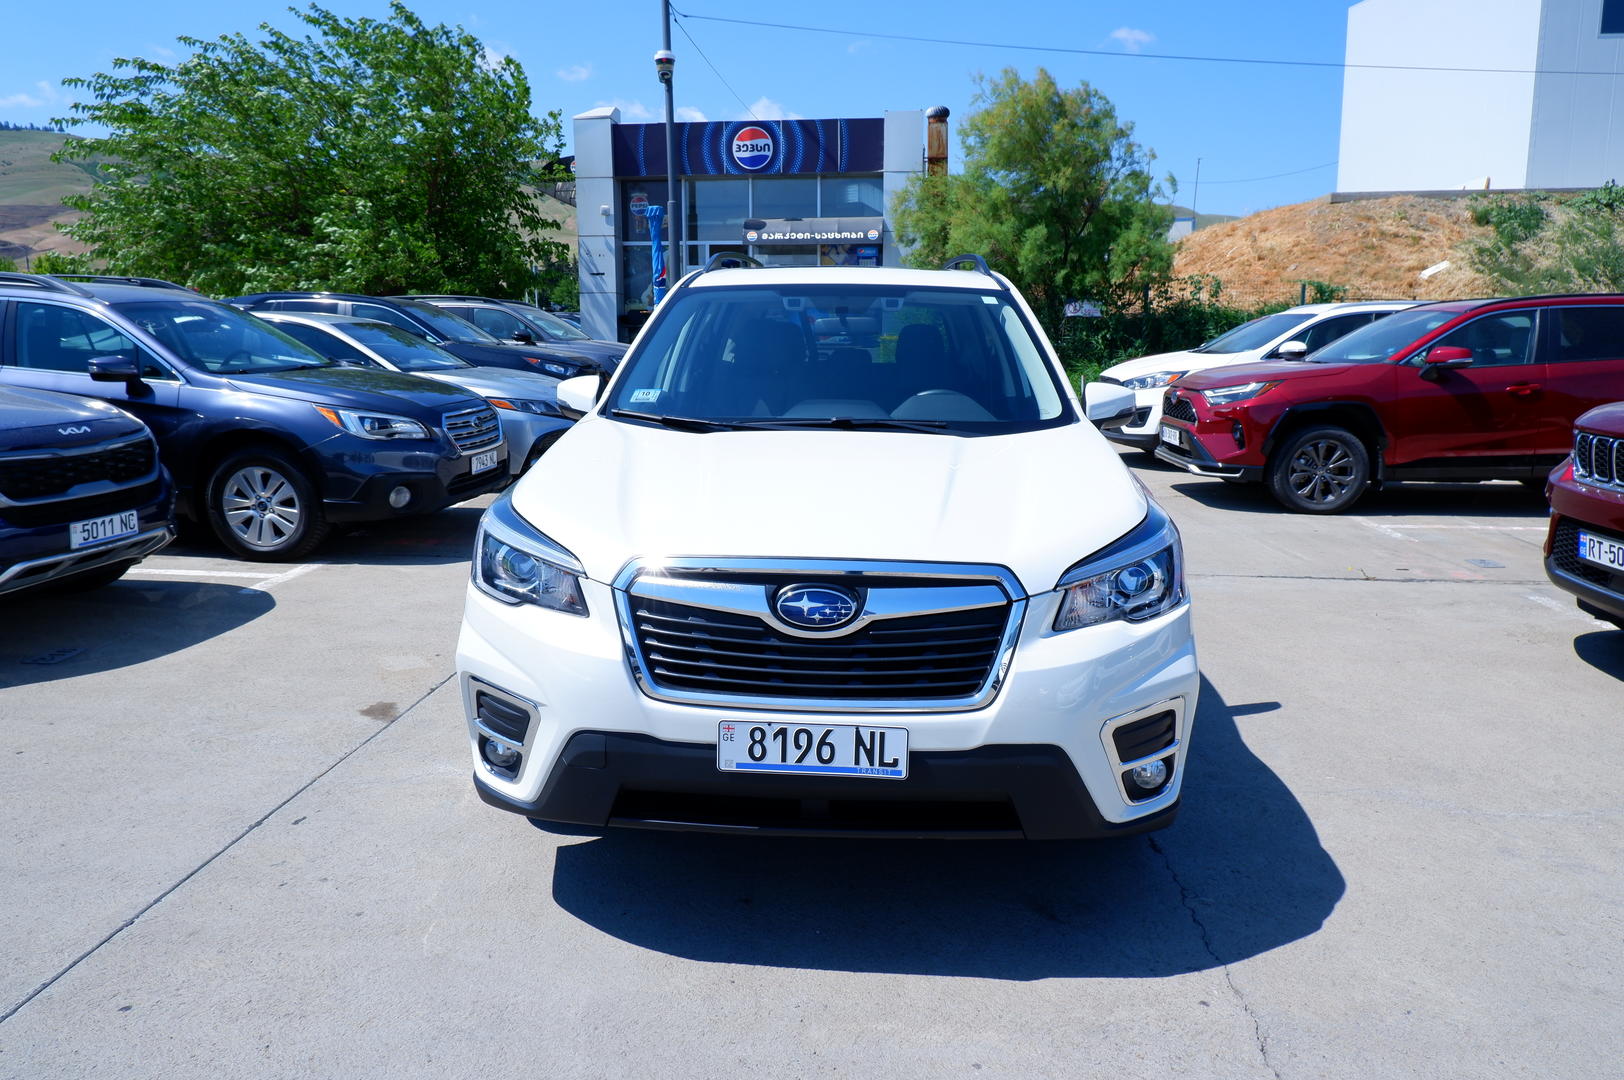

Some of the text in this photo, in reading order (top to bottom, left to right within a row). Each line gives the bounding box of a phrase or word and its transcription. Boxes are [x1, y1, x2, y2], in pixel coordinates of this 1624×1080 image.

[81, 512, 136, 542] 5011 NC
[722, 733, 735, 742] GE
[747, 726, 900, 768] 8196 NL
[856, 768, 892, 776] TRANSIT
